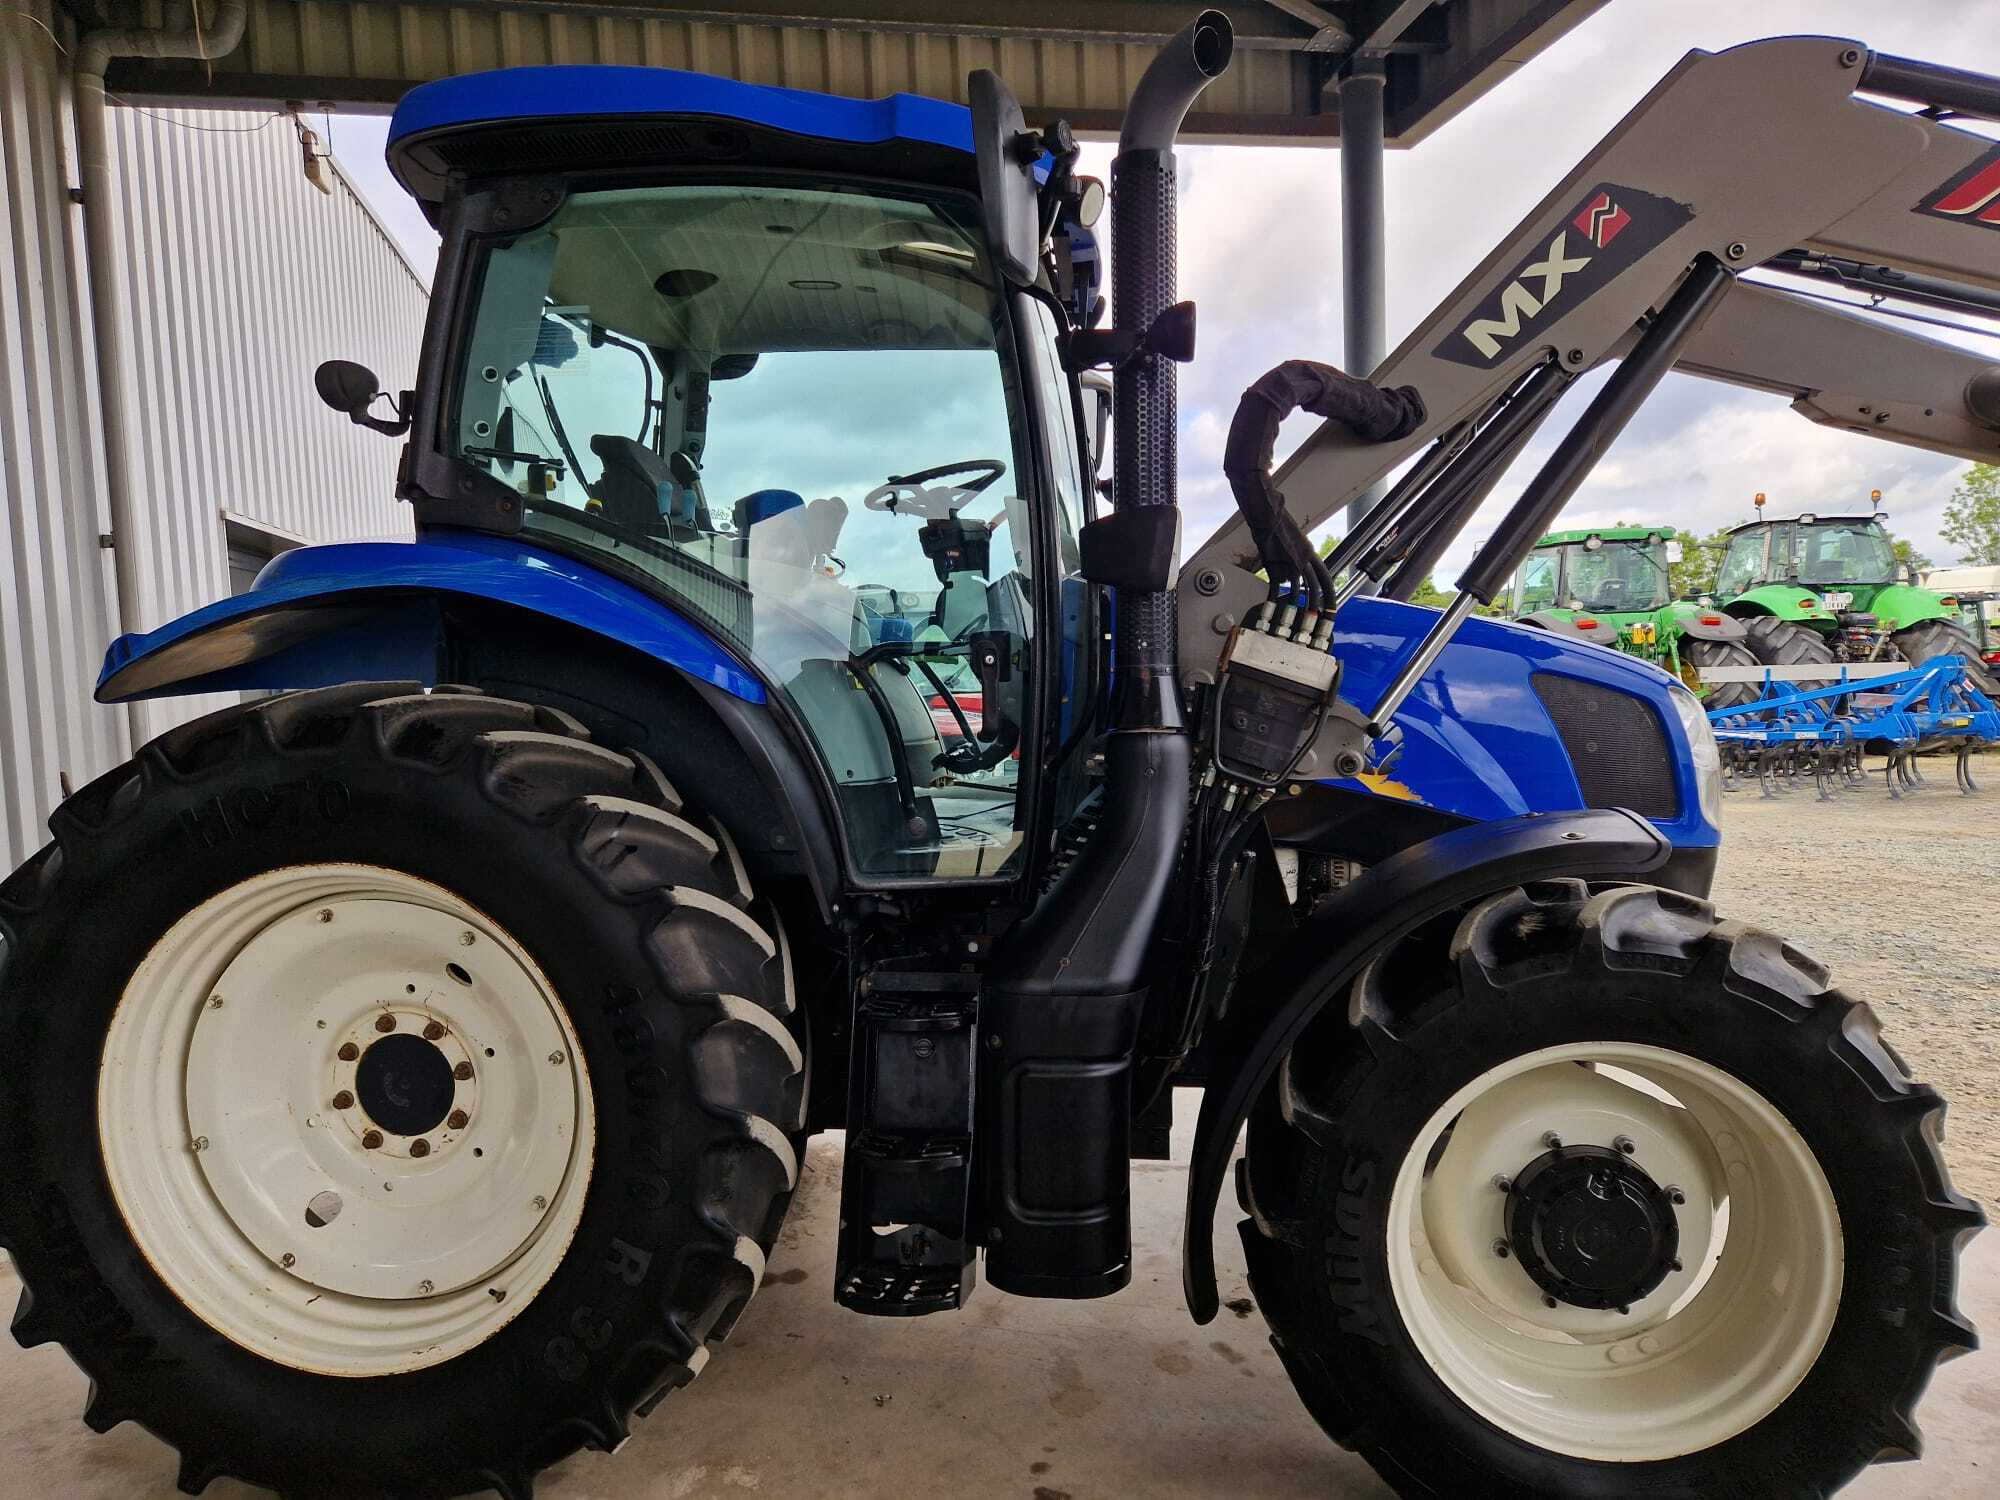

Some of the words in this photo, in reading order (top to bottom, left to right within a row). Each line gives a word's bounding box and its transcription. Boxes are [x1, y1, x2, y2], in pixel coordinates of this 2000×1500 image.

[1463, 230, 1592, 360] MX
[606, 1236, 653, 1288] R
[1324, 1152, 1387, 1346] Mitas
